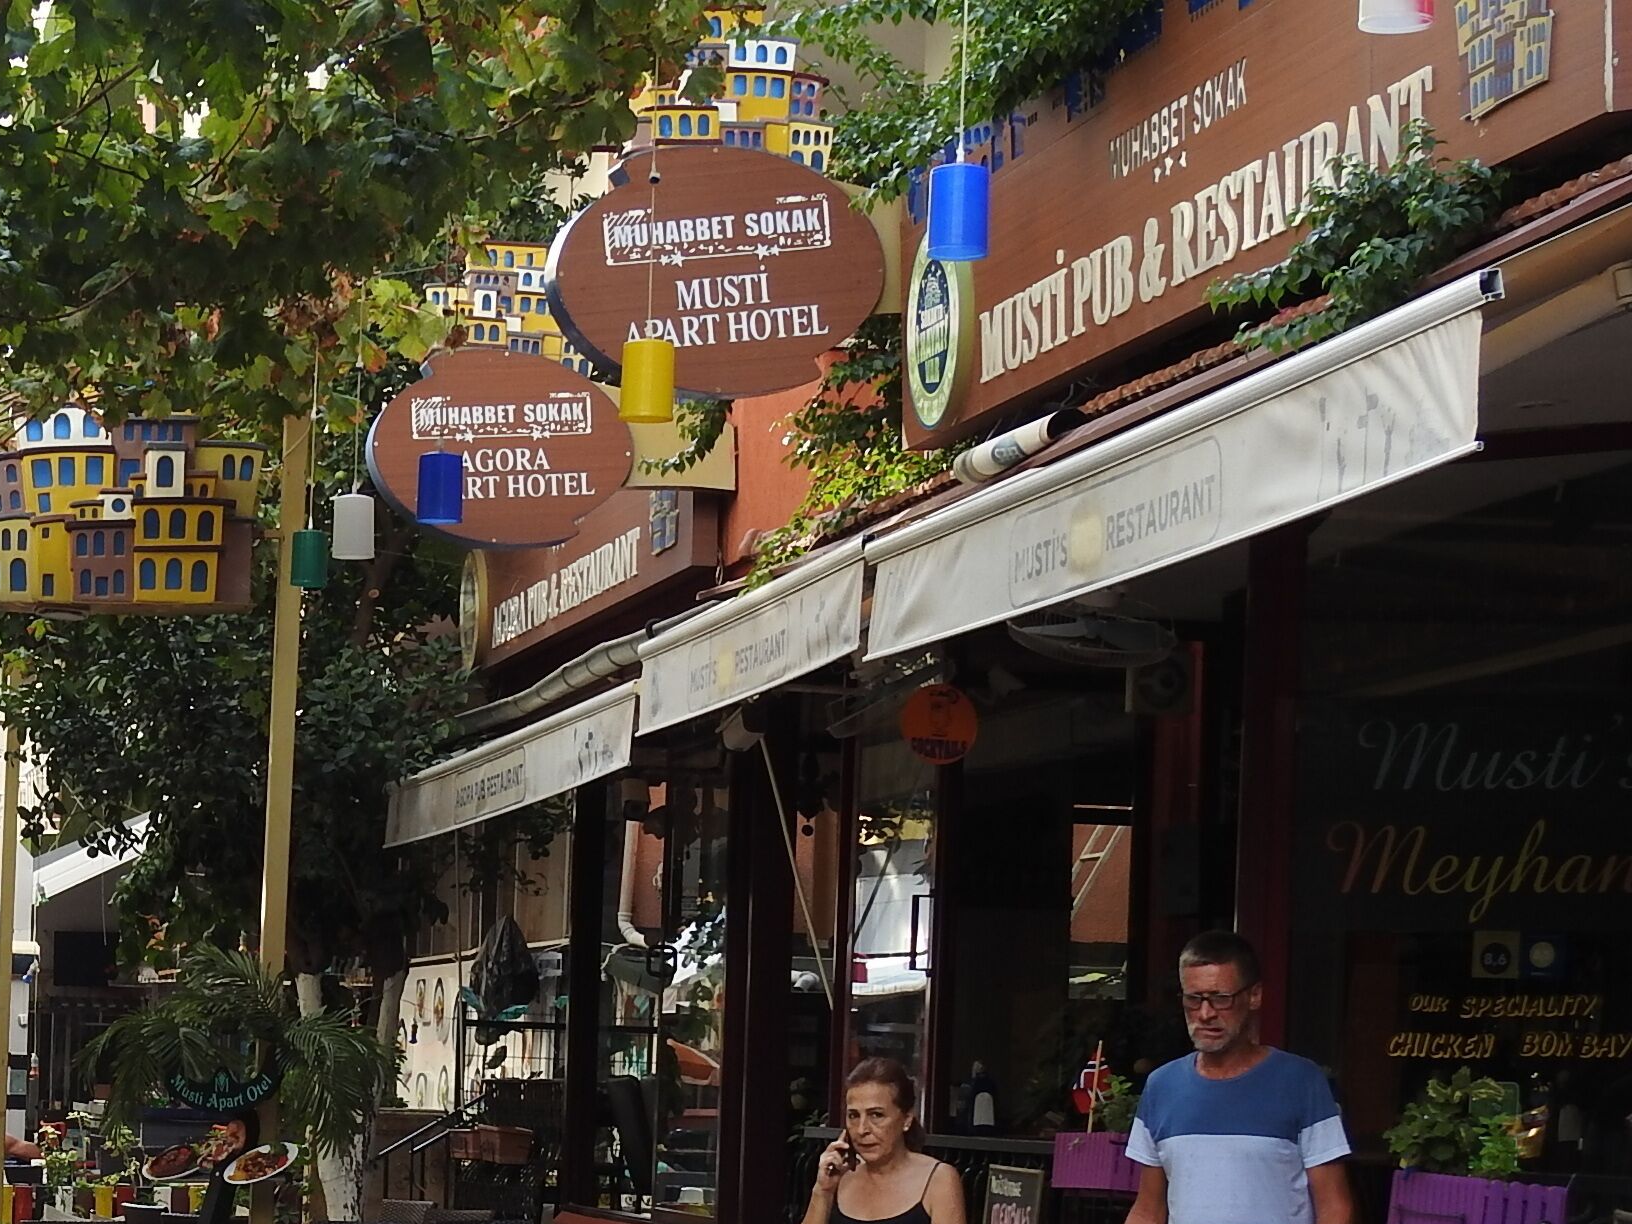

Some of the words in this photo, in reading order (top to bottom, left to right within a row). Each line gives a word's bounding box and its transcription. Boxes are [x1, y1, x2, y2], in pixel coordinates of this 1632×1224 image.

[1108, 93, 1189, 181] MUHABBET
[1192, 56, 1249, 136] SOKAK
[614, 215, 735, 249] MUHABBET
[744, 208, 822, 238] SOKAK
[674, 264, 770, 311] MUSTİ
[978, 248, 1068, 385] MUSTİ
[1070, 235, 1133, 338] PUB
[1138, 217, 1167, 303] &
[725, 304, 829, 343] HOTEL
[419, 404, 516, 427] MUHABBET
[523, 402, 584, 423] SOKAK
[462, 448, 551, 473] AGORA
[507, 472, 596, 498] HOTEL
[1105, 474, 1215, 551] RESTAURANT
[559, 527, 641, 614] RESTAURANT
[735, 628, 786, 675] RESTAURANT
[1408, 993, 1448, 1012] OUR
[1460, 994, 1599, 1019] SPECIALITY
[1387, 1032, 1497, 1059] CHICKEN
[171, 1073, 203, 1106] Musti
[206, 1093, 245, 1111] Apart
[246, 1075, 272, 1102] Otel
